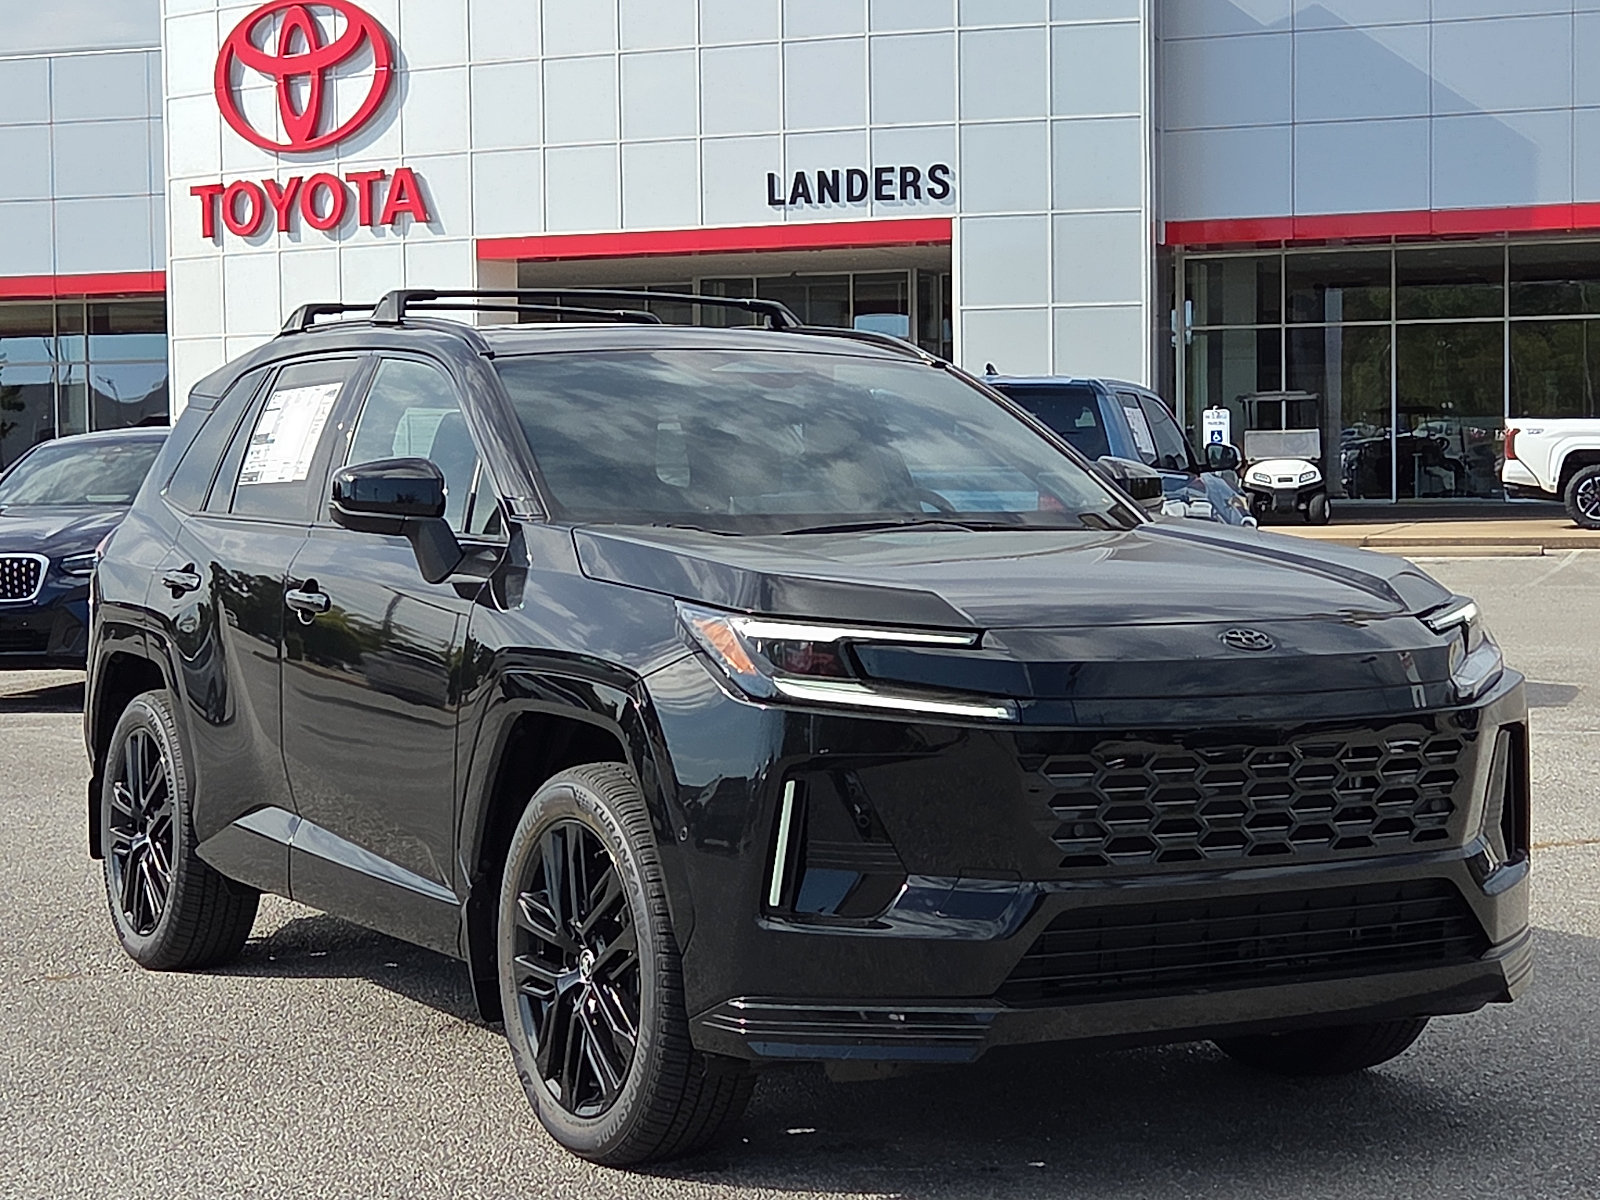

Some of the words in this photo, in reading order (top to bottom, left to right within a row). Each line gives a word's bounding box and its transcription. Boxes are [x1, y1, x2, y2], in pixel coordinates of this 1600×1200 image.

[190, 167, 431, 238] TOYOTA
[767, 164, 950, 206] LANDERS
[593, 801, 640, 897] TURANZA
